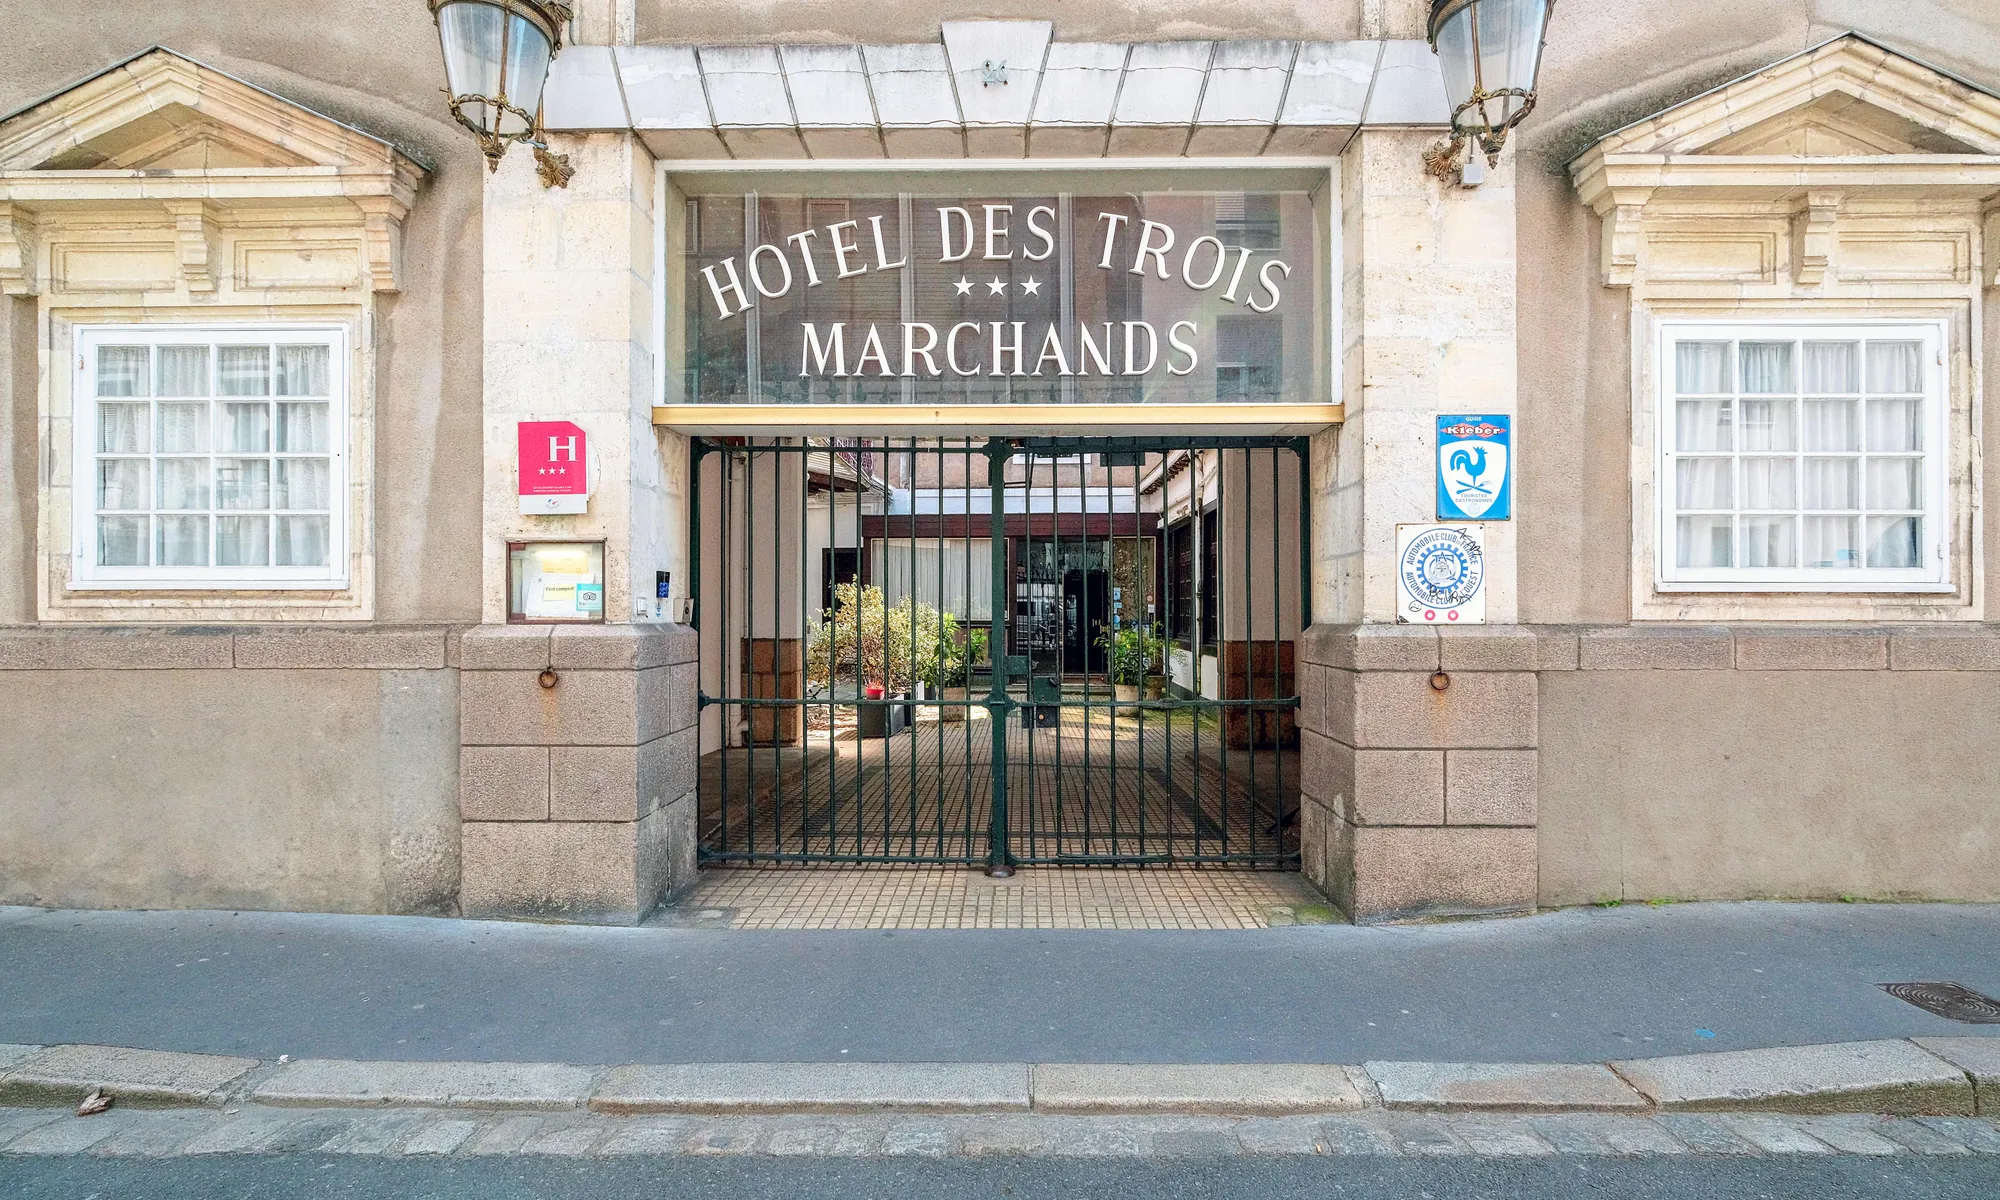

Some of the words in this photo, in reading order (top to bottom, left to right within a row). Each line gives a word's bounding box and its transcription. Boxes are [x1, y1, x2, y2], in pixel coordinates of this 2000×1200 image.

[700, 215, 907, 320] HOTEL
[936, 204, 1056, 263] DES
[1097, 211, 1292, 314] TROIS
[799, 319, 1199, 378] MARCHANDS
[547, 435, 579, 462] H
[1445, 425, 1501, 436] Kleber
